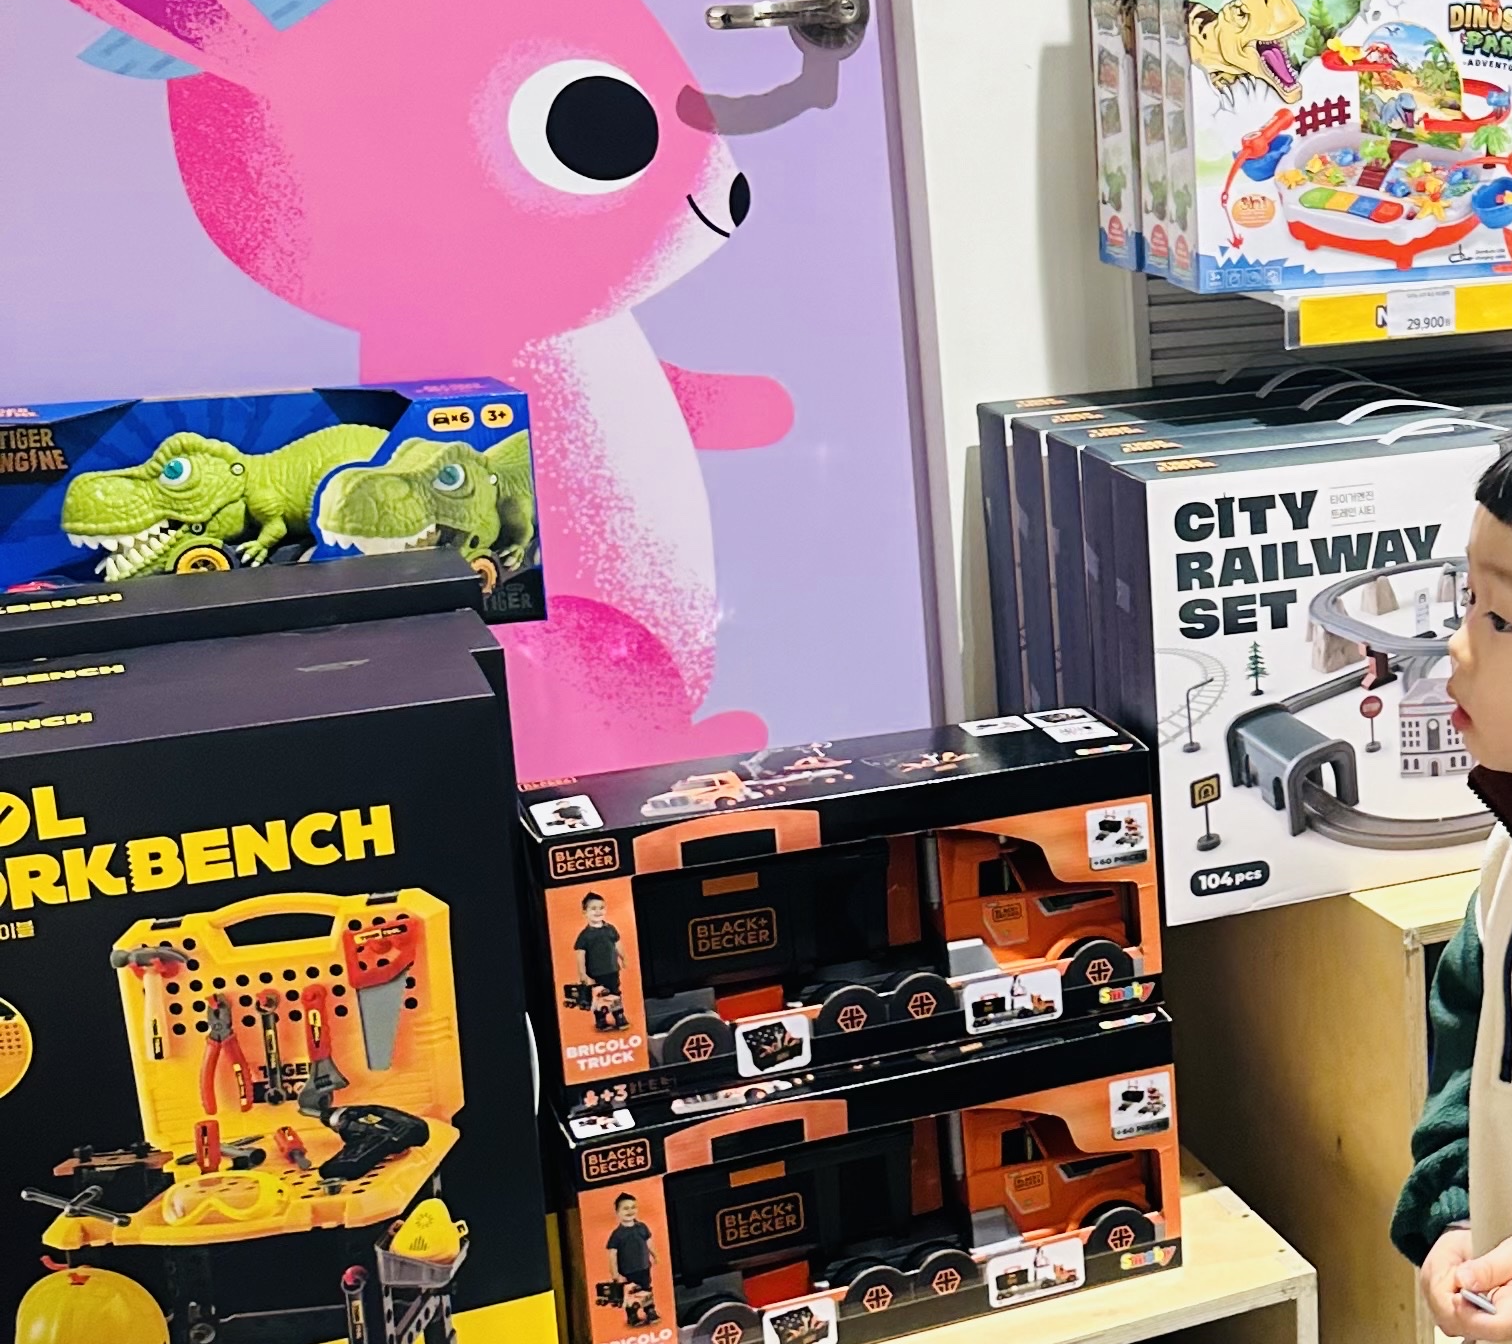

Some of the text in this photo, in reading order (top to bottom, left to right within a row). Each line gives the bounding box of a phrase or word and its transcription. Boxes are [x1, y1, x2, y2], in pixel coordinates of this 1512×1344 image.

[1406, 313, 1452, 331] 29,900원
[487, 408, 507, 423] 3+
[0, 428, 55, 451] TIGER
[1329, 488, 1375, 505] 타이거엔진
[1173, 489, 1319, 544] CITY
[1176, 523, 1442, 592] RAILWAY
[1178, 589, 1299, 640] SET
[555, 844, 612, 864] BLACK+
[555, 855, 615, 875] DECKER
[696, 914, 768, 940] BLACK+
[697, 927, 771, 952] DECKER
[1098, 981, 1155, 1005] Smoby
[565, 1034, 643, 1060] BRICOLO
[576, 1049, 635, 1071] TRUCK
[600, 1084, 629, 1105] +3
[587, 1144, 645, 1164] BLACK+
[588, 1156, 648, 1175] DECKER
[723, 1197, 796, 1228] BLACK+
[726, 1214, 798, 1241] DECKER
[1119, 1245, 1177, 1270] Smoby
